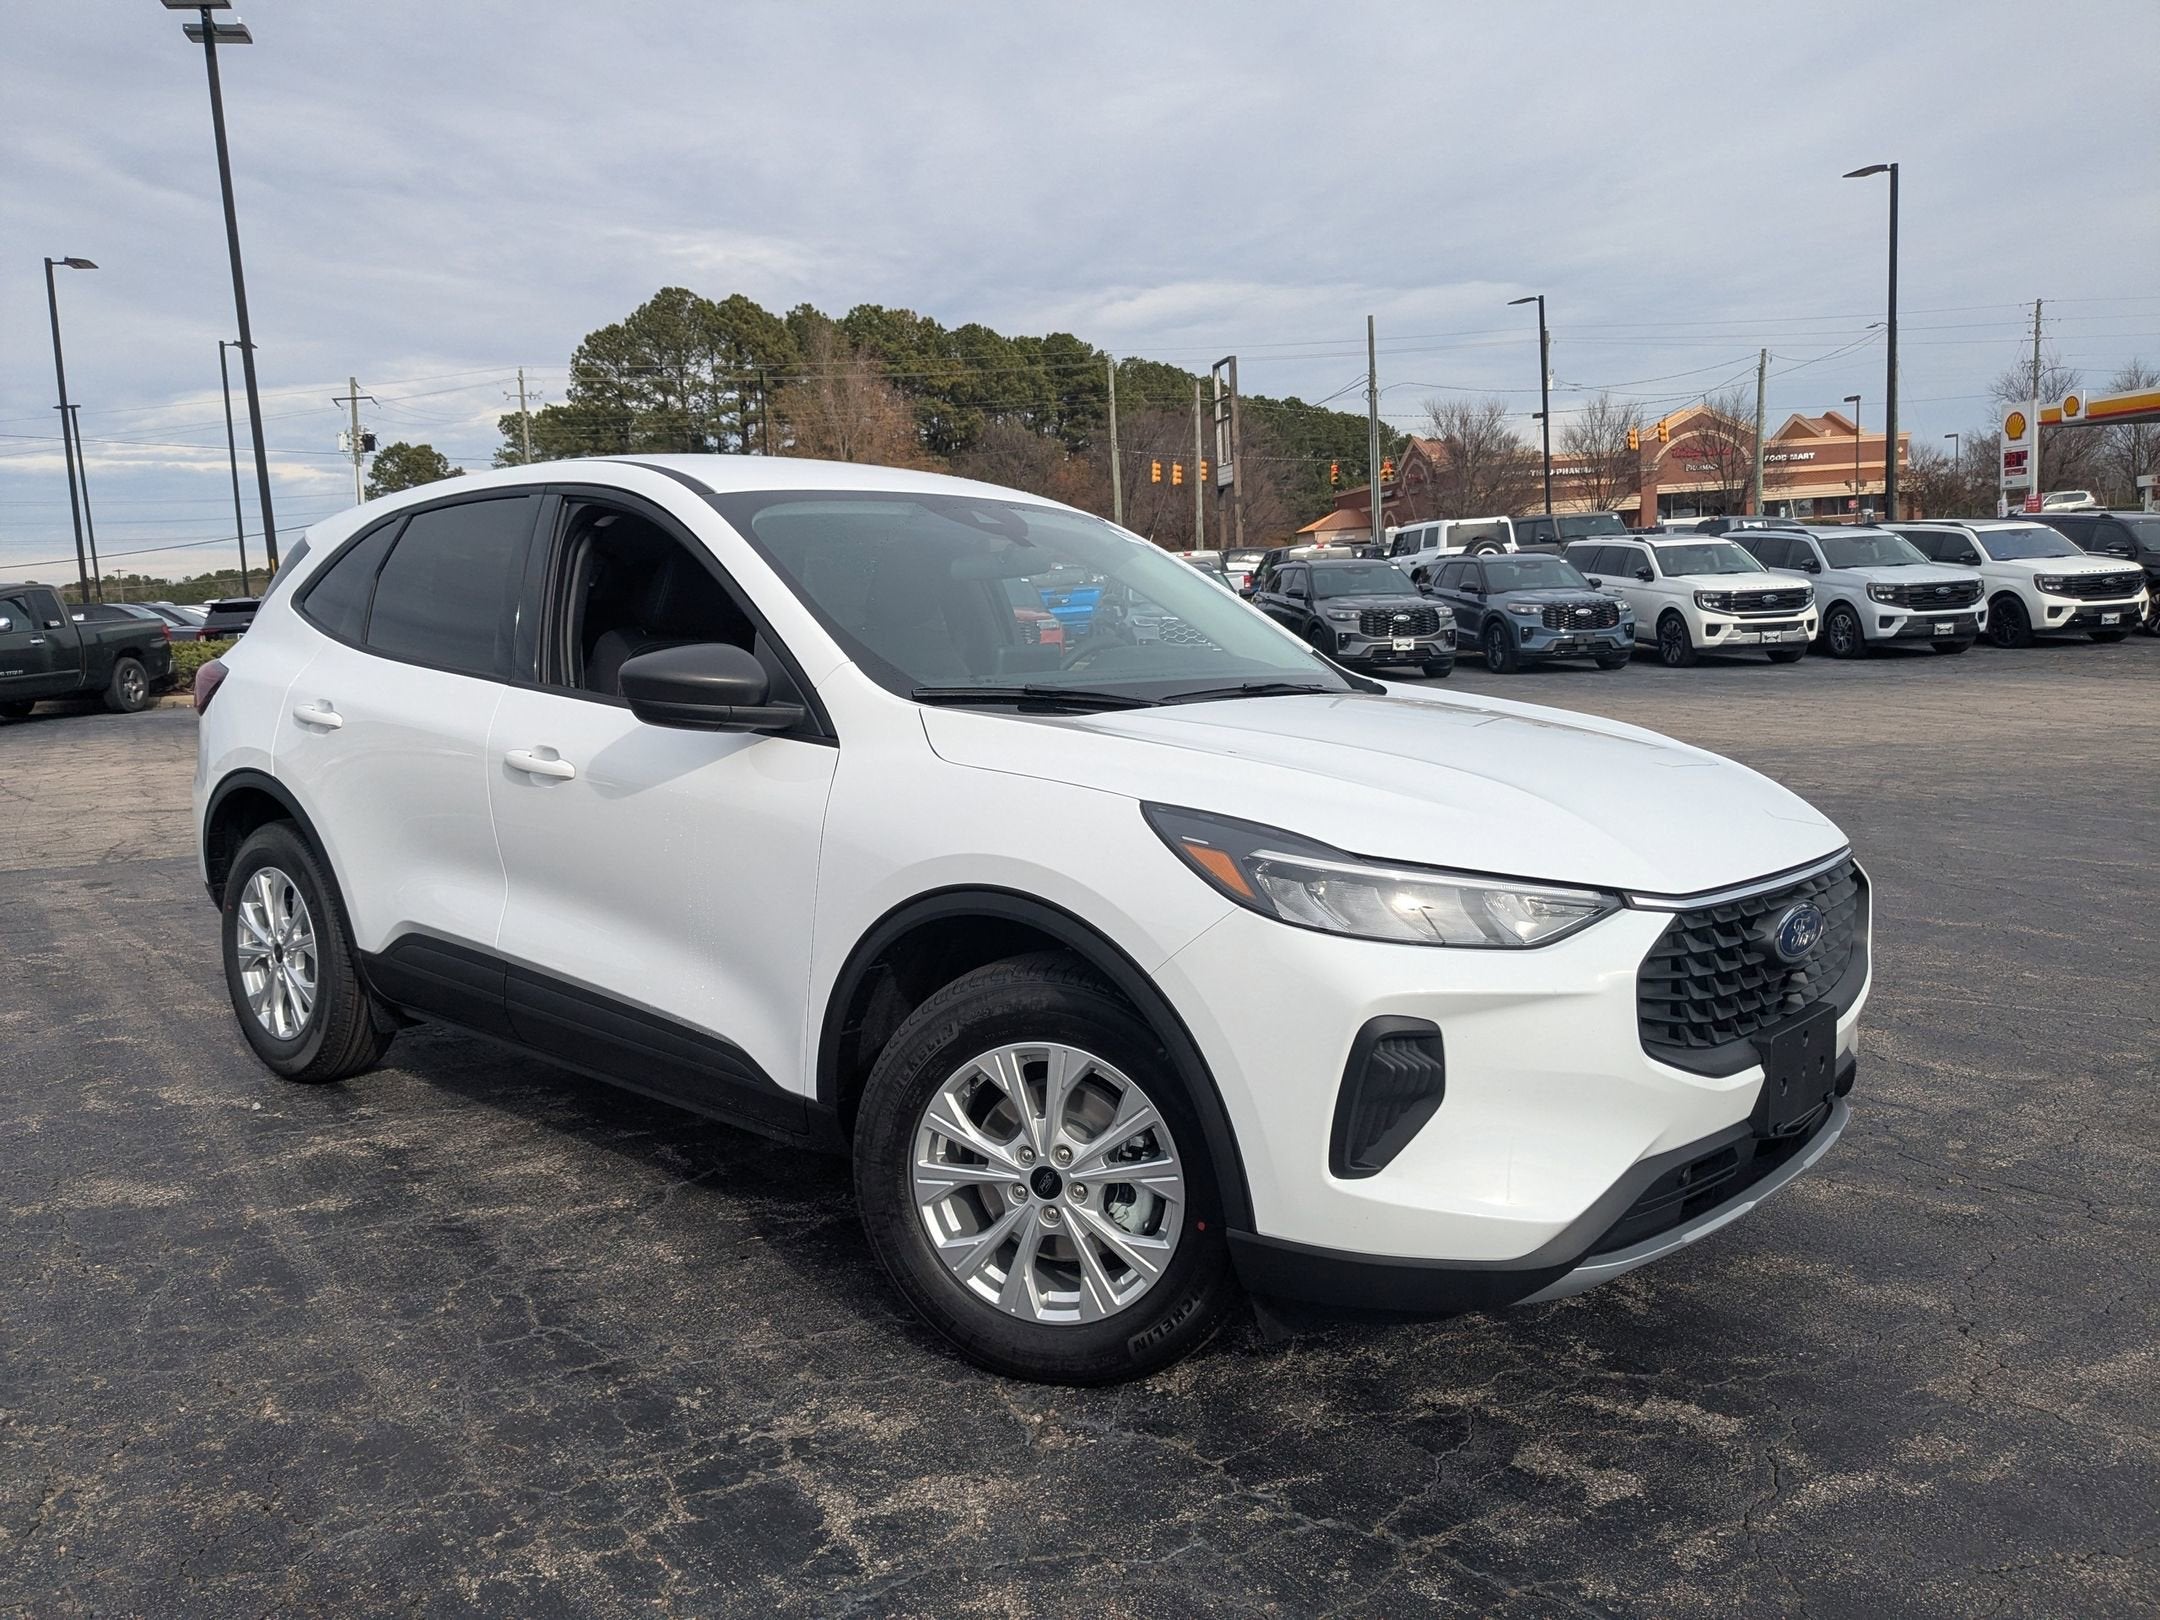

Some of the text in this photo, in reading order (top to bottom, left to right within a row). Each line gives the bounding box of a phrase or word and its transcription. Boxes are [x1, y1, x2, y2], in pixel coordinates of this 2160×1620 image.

[1789, 452, 1816, 460] MART
[1791, 916, 1819, 950] Ford
[1133, 1291, 1203, 1353] ICHELIN
